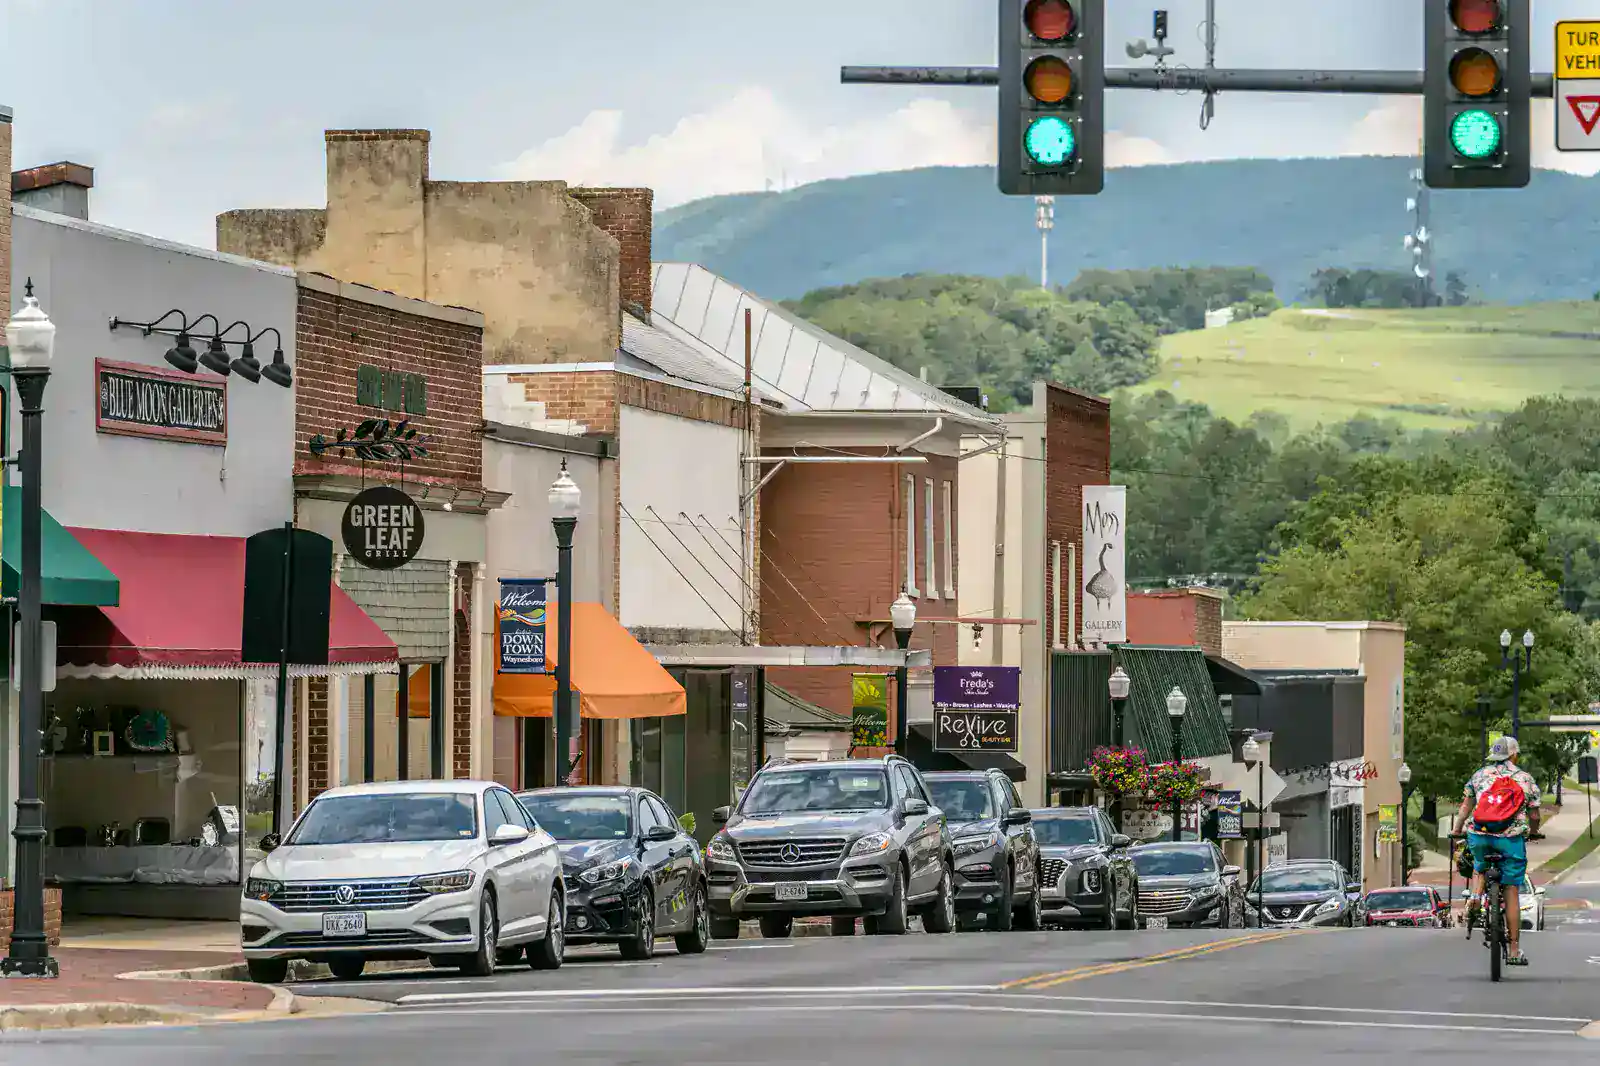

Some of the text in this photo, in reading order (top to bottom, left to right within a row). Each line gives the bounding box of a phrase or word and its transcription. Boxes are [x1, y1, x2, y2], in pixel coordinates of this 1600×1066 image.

[108, 376, 218, 428] BLUE MOON GALLERIES
[350, 505, 414, 527] GREEN
[365, 527, 414, 550] LEAF
[365, 550, 408, 558] GRILL
[501, 589, 546, 606] Welcome
[1085, 620, 1122, 630] GALLERY
[503, 634, 543, 644] DOWN
[503, 644, 543, 654] TOWN
[503, 655, 543, 664] Waynesboro
[960, 678, 994, 688] Freda's
[853, 713, 887, 726] Welcome
